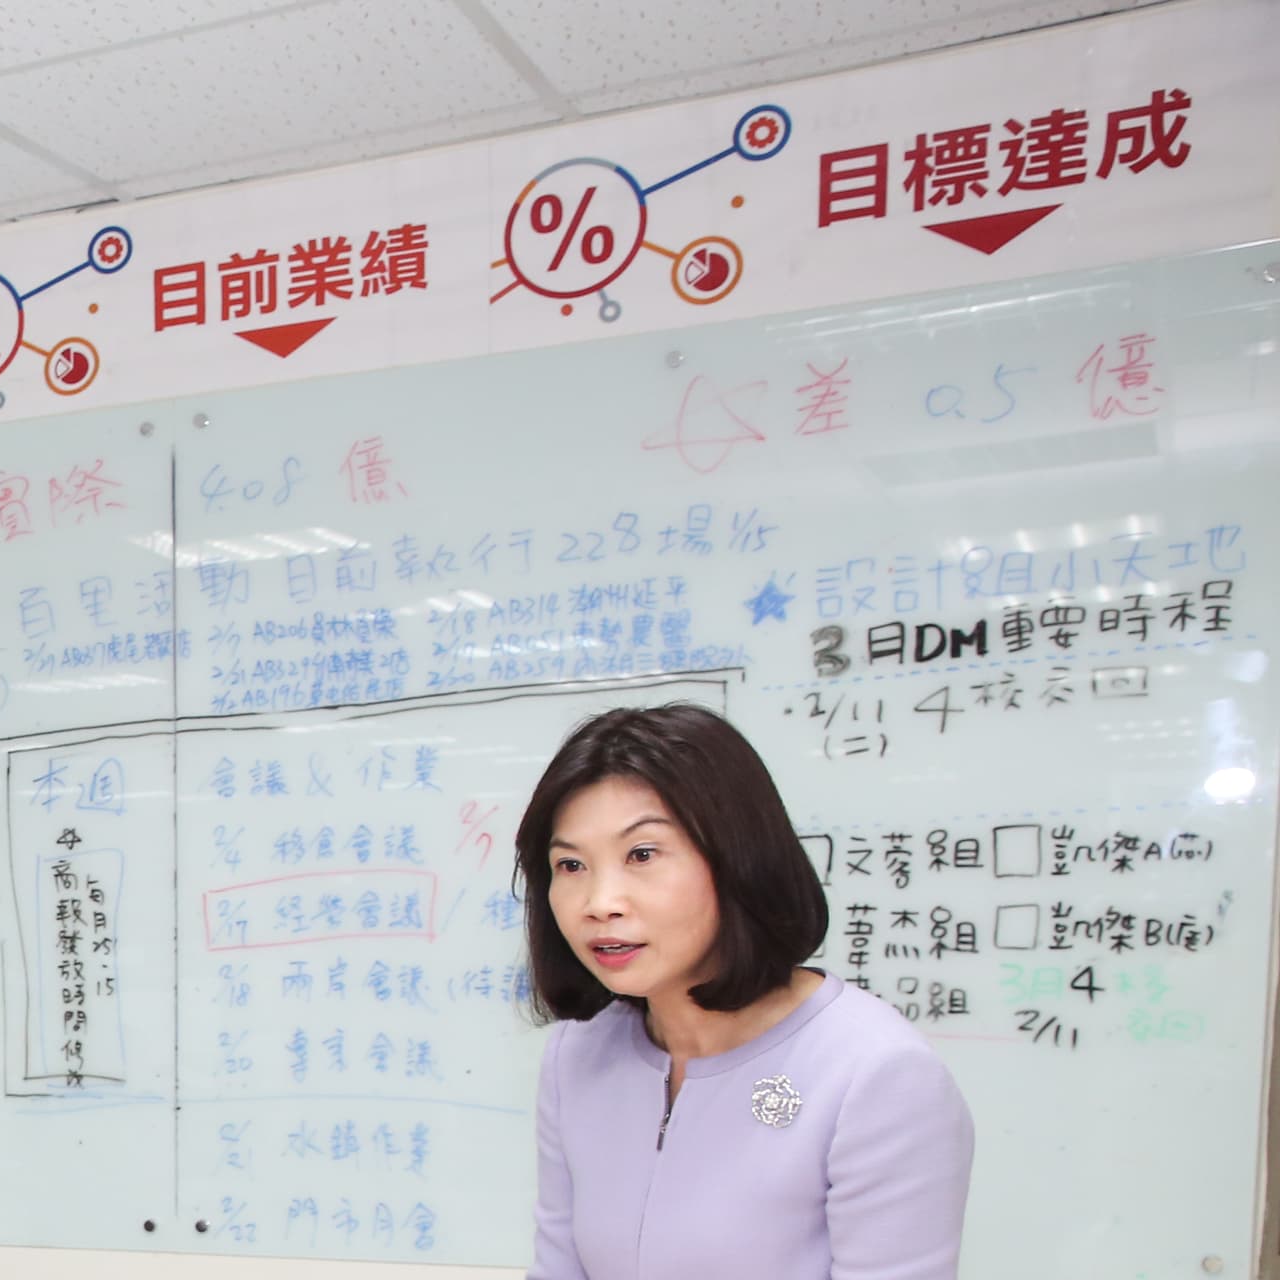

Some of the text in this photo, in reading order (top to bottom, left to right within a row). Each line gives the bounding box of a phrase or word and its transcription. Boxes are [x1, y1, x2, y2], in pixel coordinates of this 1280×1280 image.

[817, 87, 1192, 229] 目標達成
[152, 222, 429, 332] 目前業績
